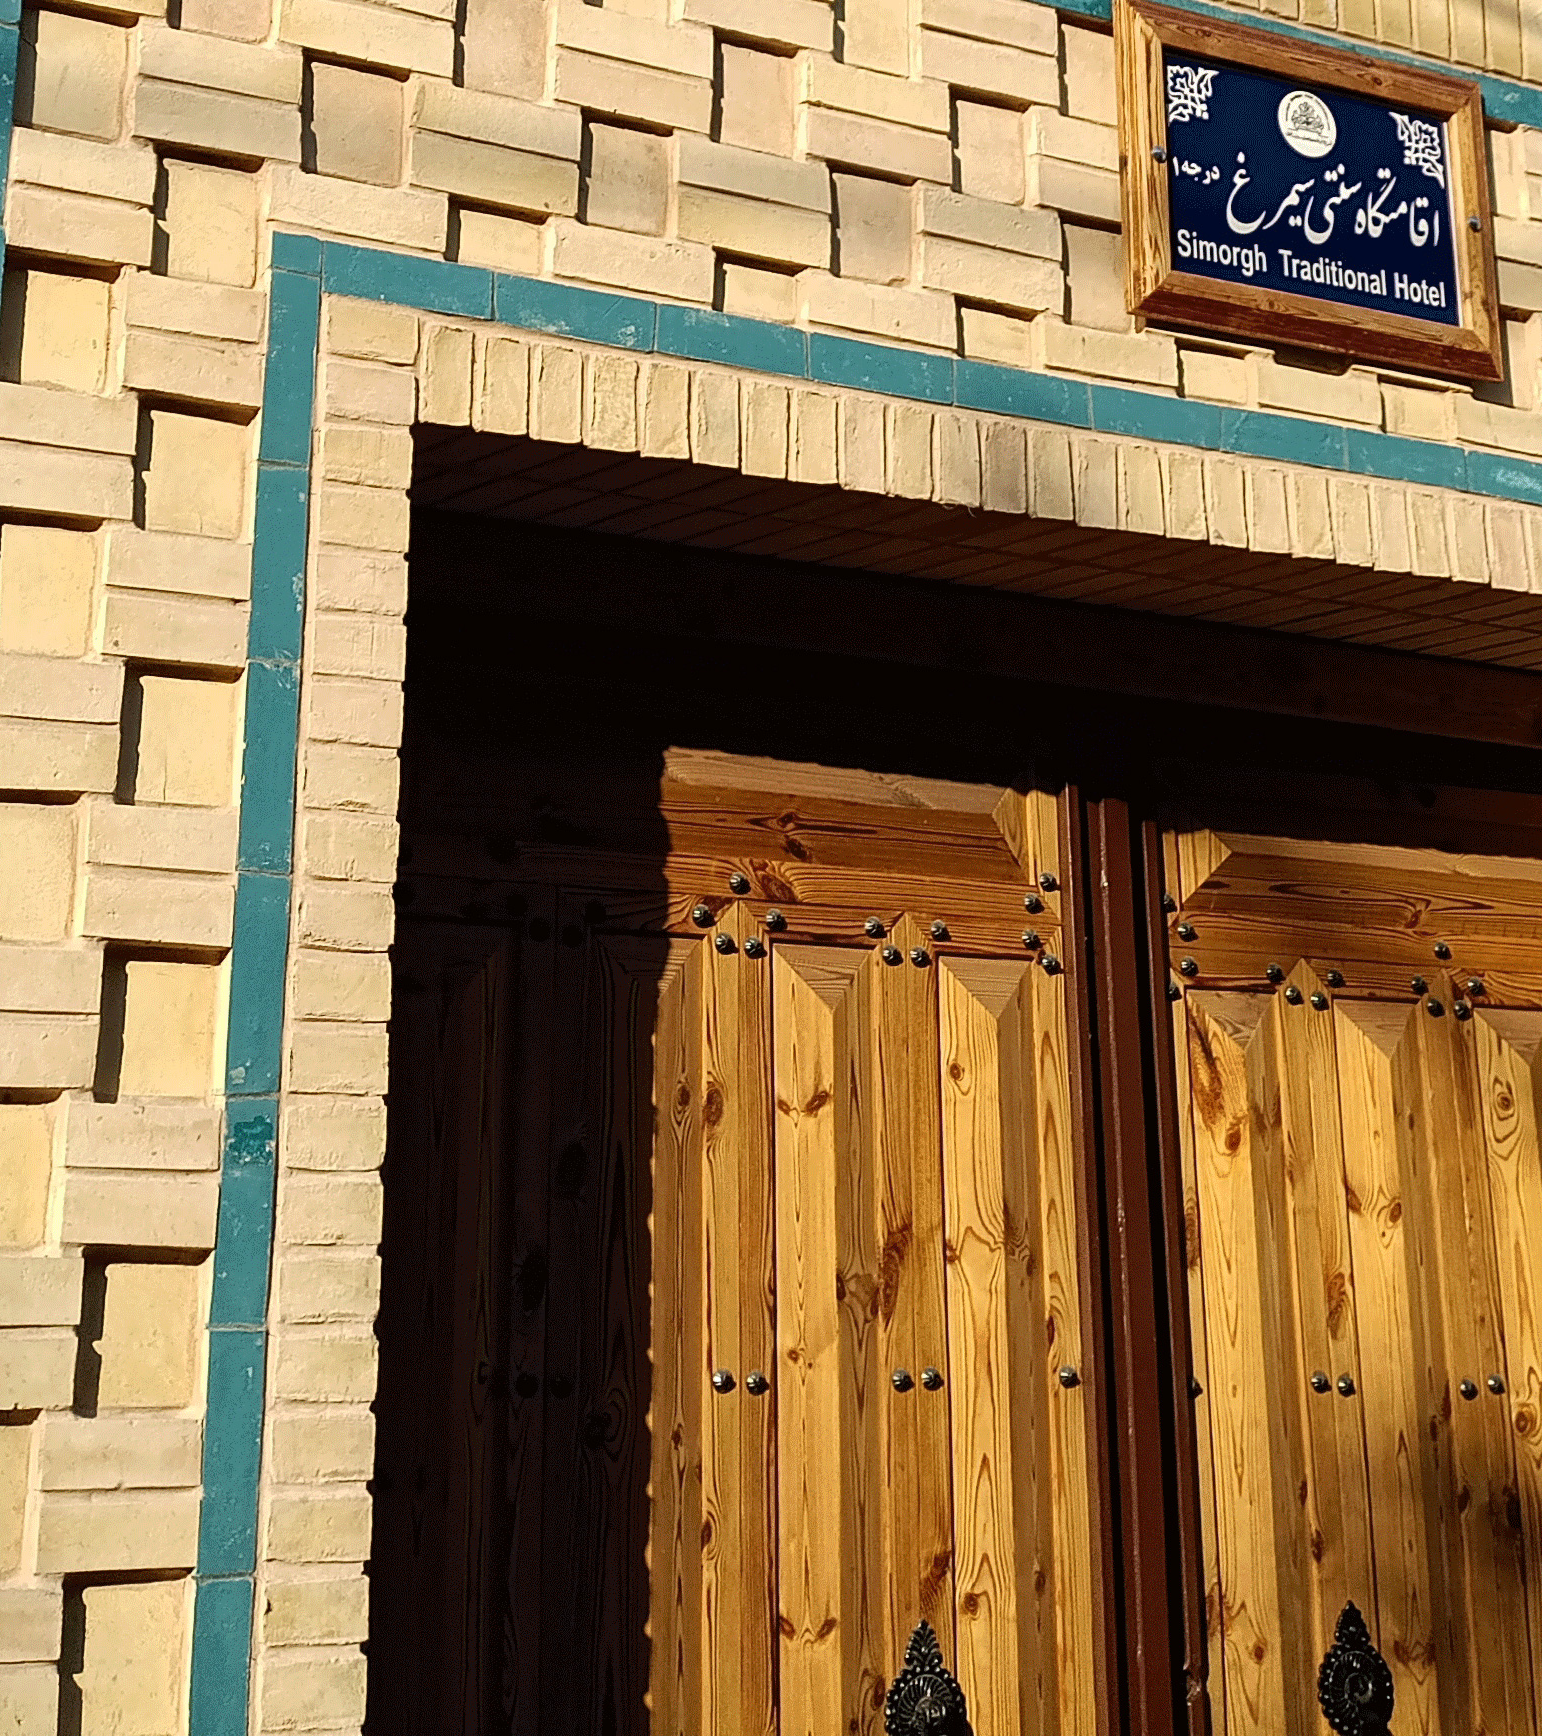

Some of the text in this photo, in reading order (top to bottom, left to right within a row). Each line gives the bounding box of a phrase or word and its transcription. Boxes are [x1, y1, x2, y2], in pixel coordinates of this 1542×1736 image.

[1226, 151, 1440, 247] اقامتگاه سنتی سیمرغ
[1177, 229, 1447, 308] Simorgh Traditional Hotel
